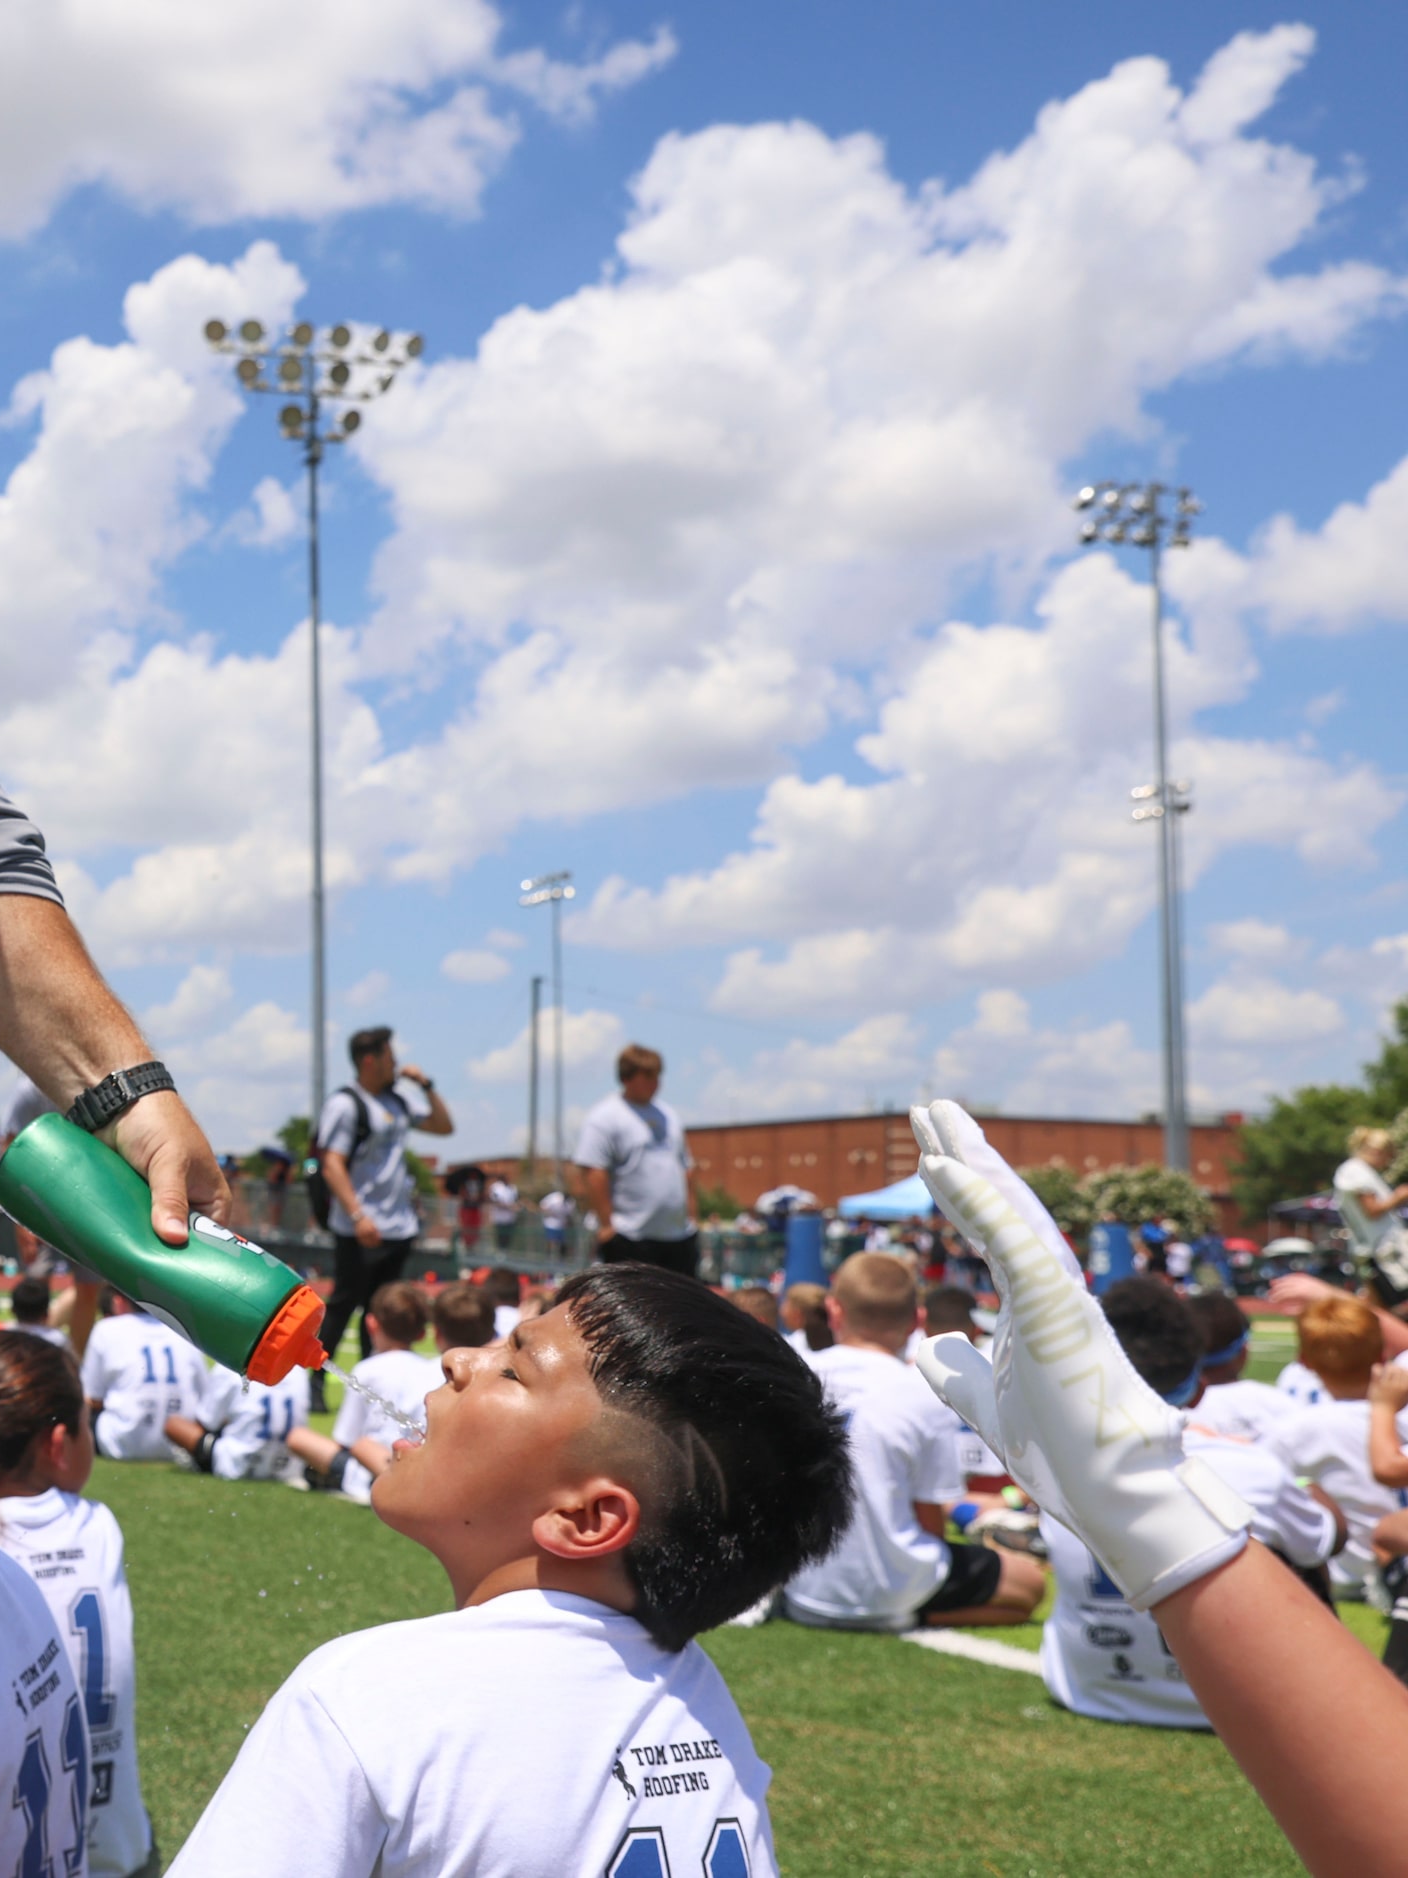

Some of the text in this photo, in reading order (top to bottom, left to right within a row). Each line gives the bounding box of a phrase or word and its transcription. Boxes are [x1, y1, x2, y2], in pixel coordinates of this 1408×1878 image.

[141, 1346, 178, 1384] 11
[256, 1395, 295, 1442] 11
[630, 1739, 723, 1767] TOM DRAKE
[643, 1771, 710, 1798] ROOFING
